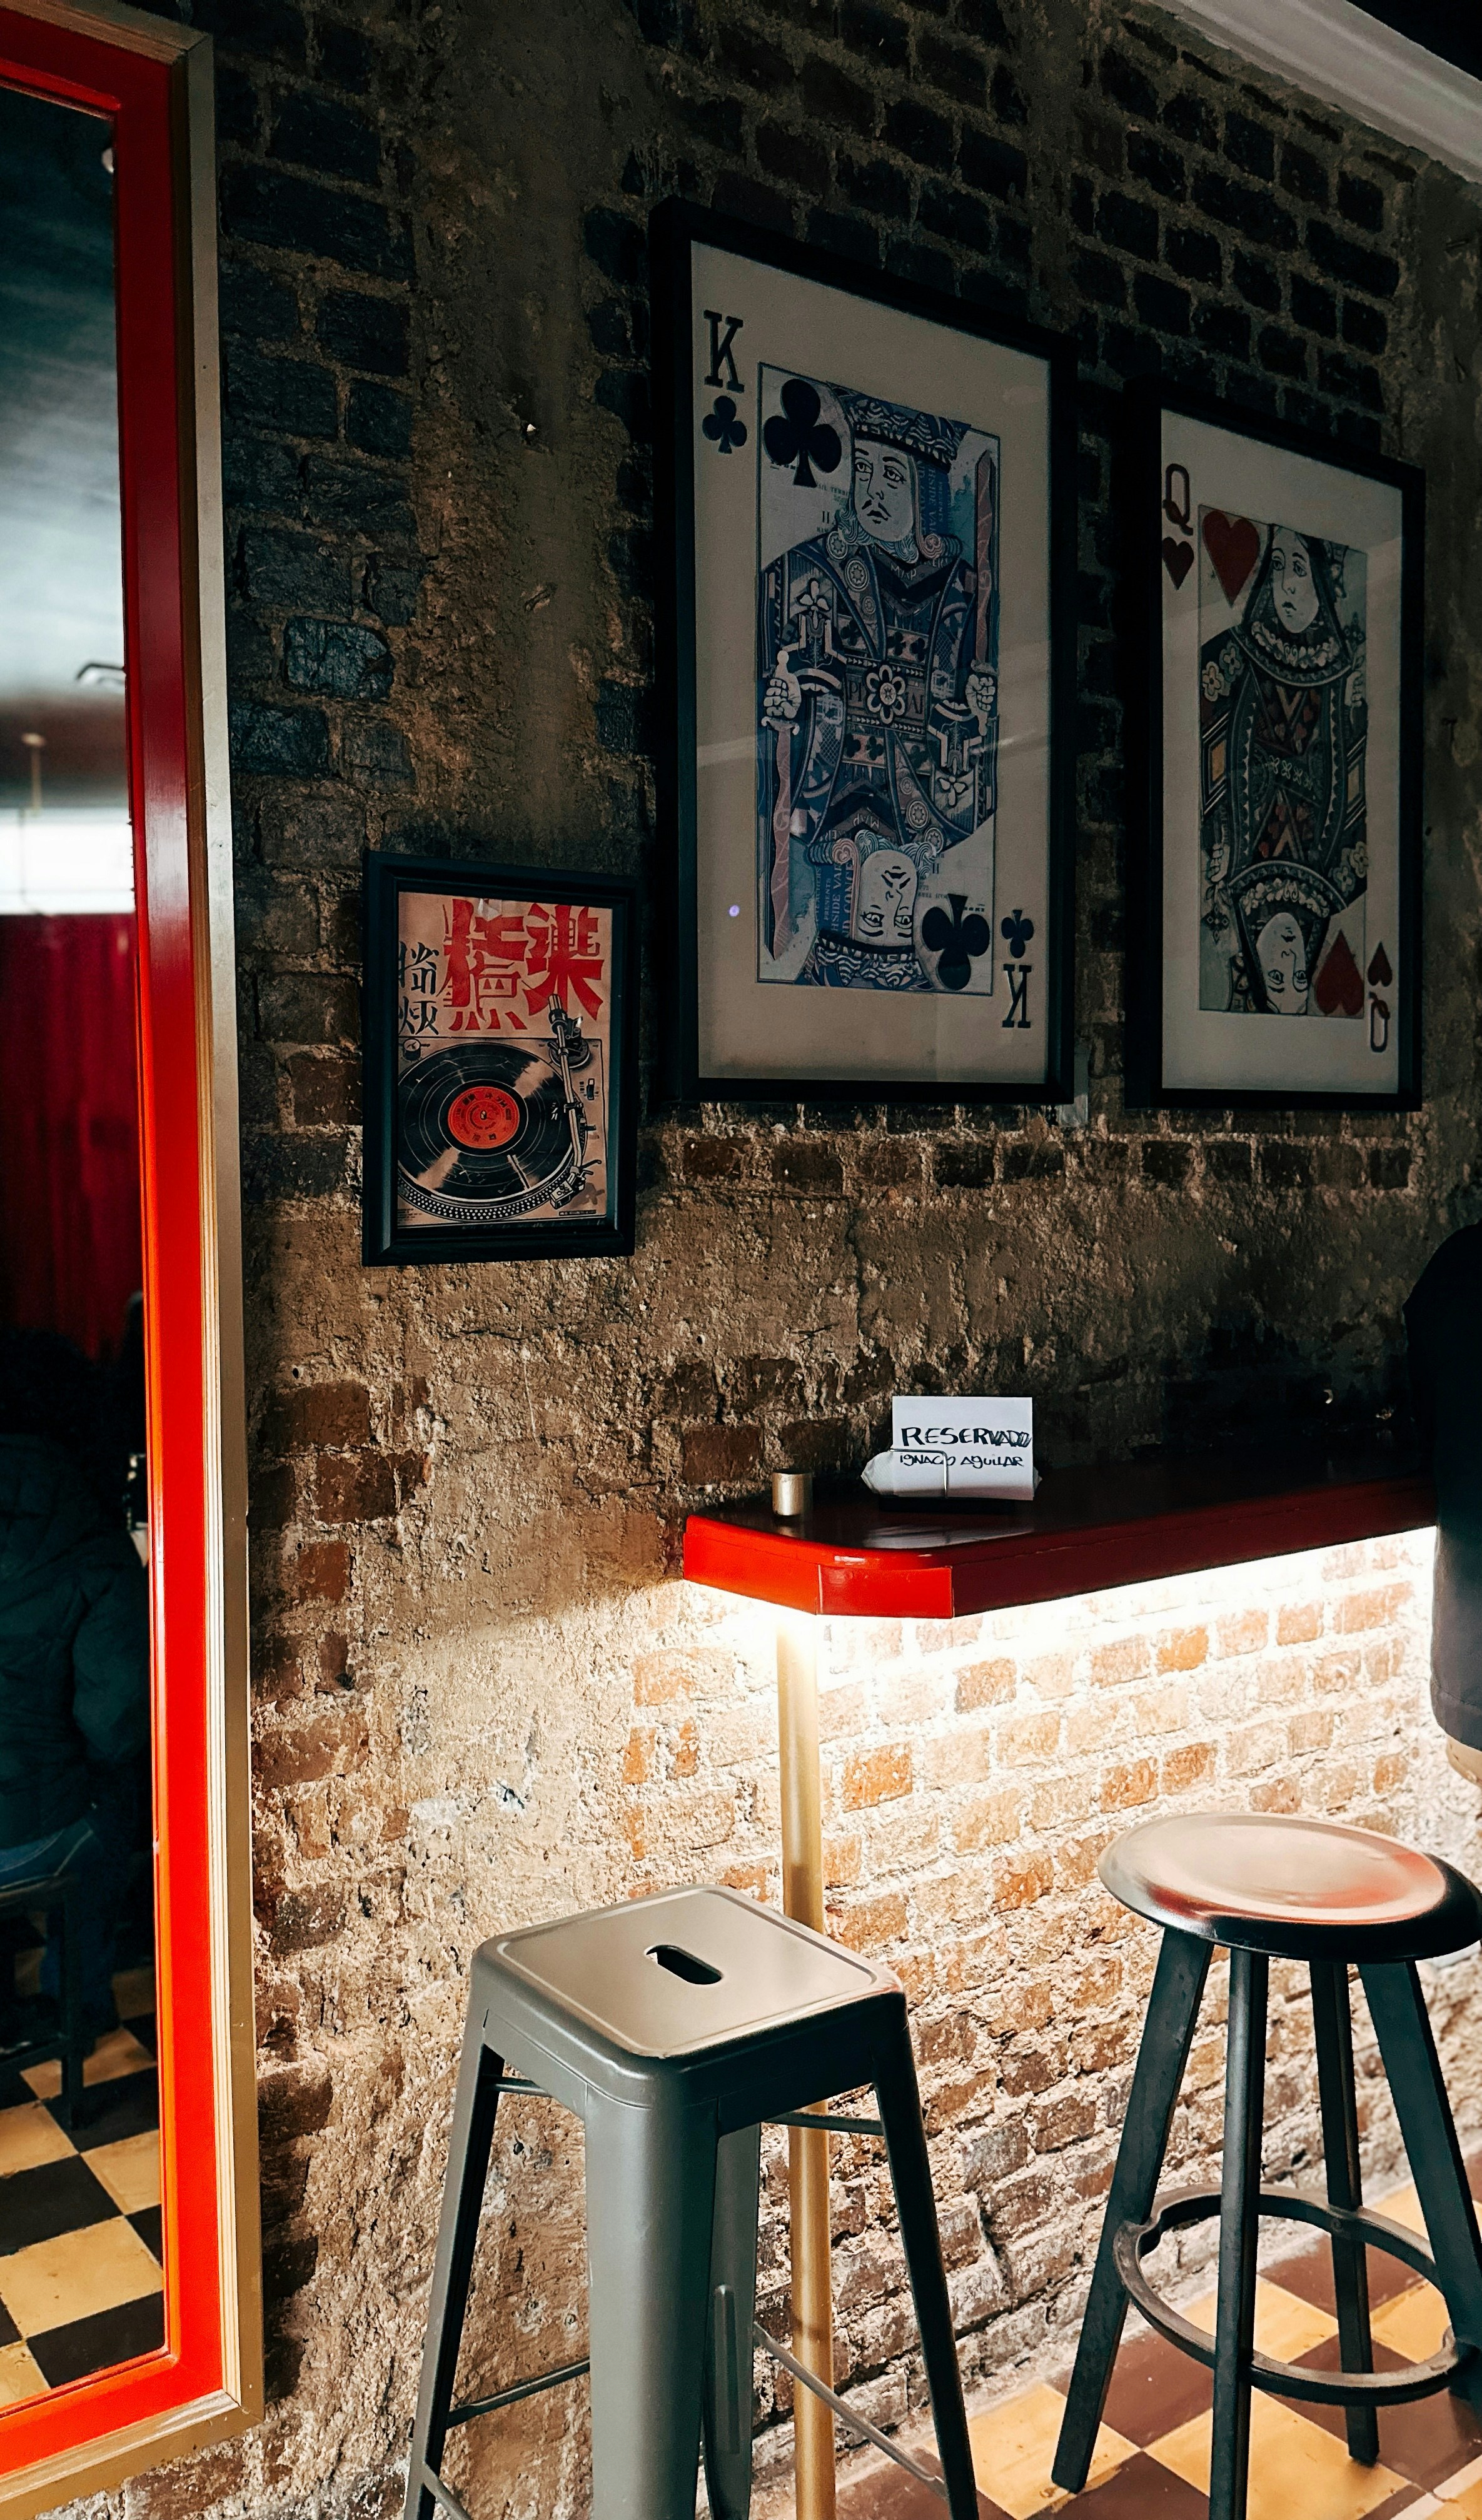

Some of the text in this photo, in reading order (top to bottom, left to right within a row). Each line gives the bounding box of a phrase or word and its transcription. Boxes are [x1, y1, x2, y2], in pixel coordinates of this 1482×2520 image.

[703, 310, 744, 393] K
[1162, 464, 1193, 536] Q
[1002, 963, 1032, 1028] K
[1369, 992, 1390, 1052] Q
[901, 1427, 1032, 1447] RESERVADO
